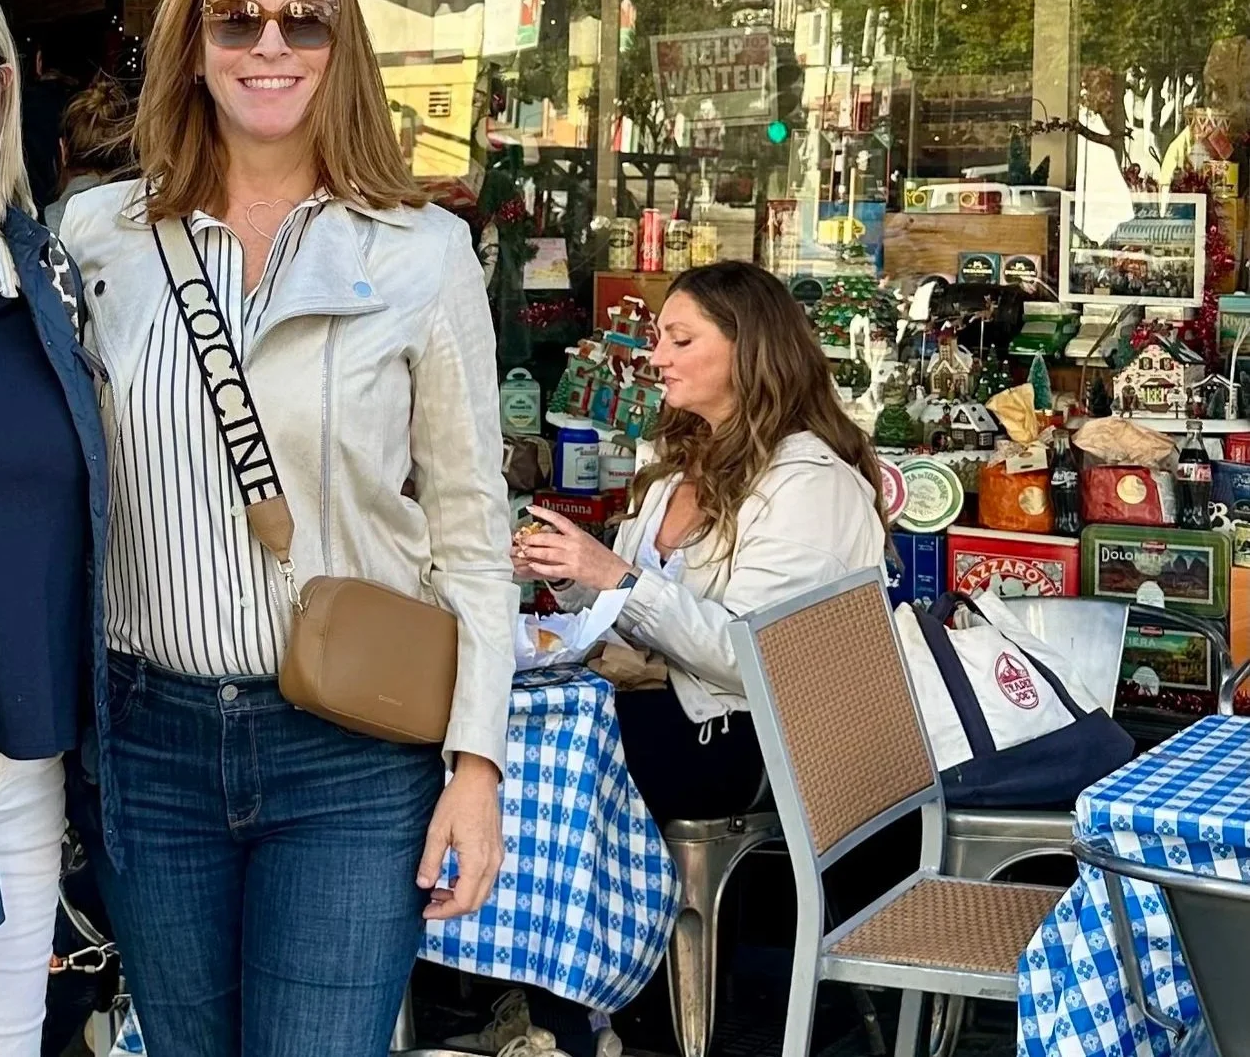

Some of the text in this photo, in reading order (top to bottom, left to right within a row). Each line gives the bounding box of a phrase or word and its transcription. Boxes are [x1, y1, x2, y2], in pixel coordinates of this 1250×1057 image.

[682, 36, 744, 65] HELP
[663, 63, 767, 95] WANTED
[958, 559, 1055, 596] LAZZARONI
